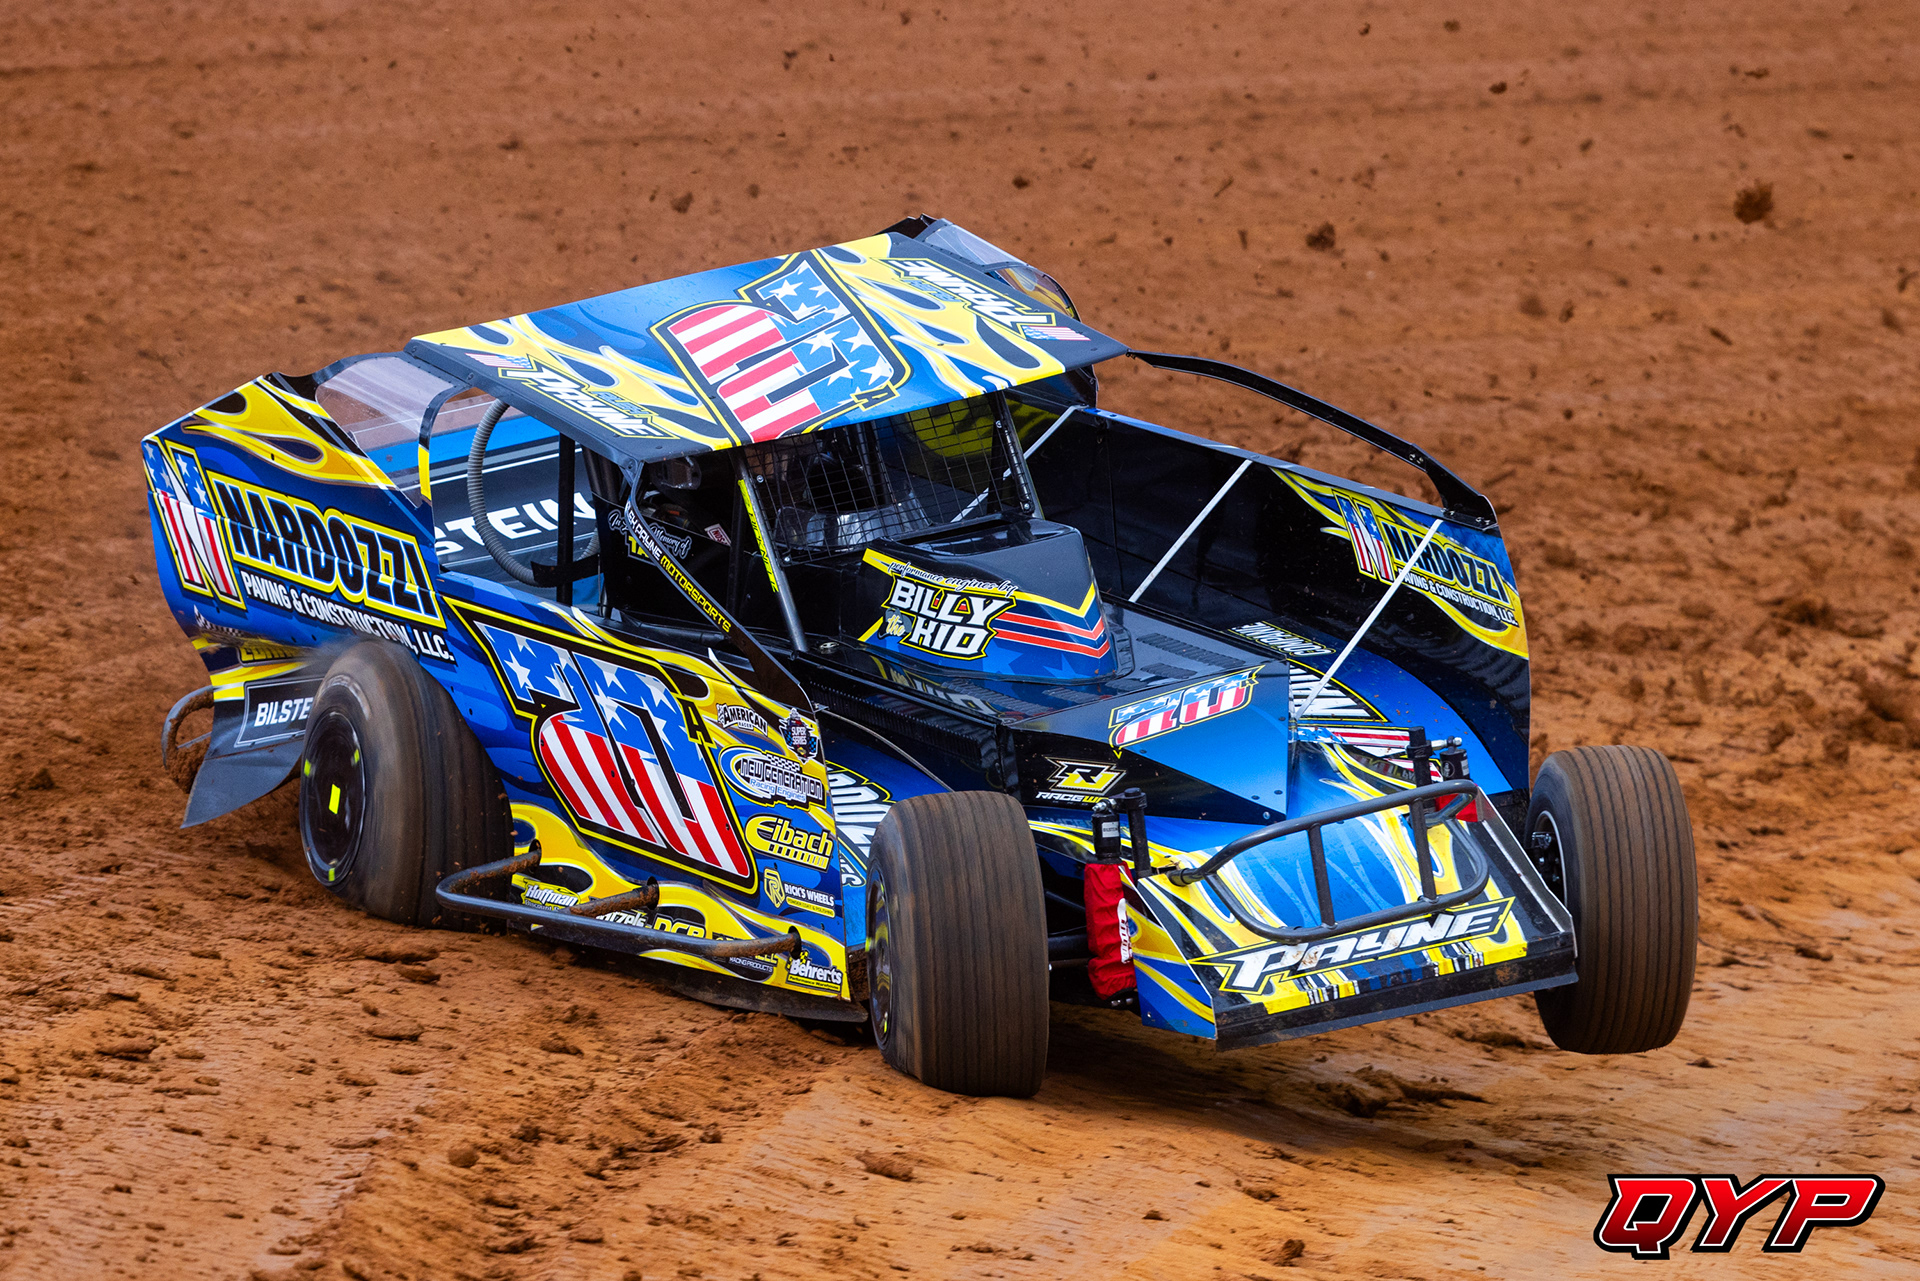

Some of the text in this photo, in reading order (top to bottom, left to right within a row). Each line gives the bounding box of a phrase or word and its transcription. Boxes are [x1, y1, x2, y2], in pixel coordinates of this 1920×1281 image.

[505, 370, 664, 437] PAYNE
[434, 492, 597, 556] STEIN
[214, 480, 440, 619] NARDOZZI
[1380, 520, 1511, 604] NARDOZZI
[660, 555, 732, 633] MOTORSPORTS
[888, 562, 1019, 598] performance engines by
[1398, 567, 1429, 592] AVING
[240, 570, 292, 610] PAVING
[292, 588, 303, 614] &
[412, 628, 455, 661] LLC.
[889, 578, 1012, 627] BILLY
[909, 616, 989, 654] KID
[254, 697, 313, 727] BILSTE
[722, 705, 767, 734] AMERICAN
[791, 726, 806, 736] SUPER
[740, 759, 823, 801] NEW GENERATION
[750, 778, 807, 803] Racing Engines
[745, 816, 833, 859] Eibach
[525, 884, 579, 907] Hoffman
[784, 883, 835, 907] RICK'S WHEELS
[1225, 906, 1500, 989] PAYNE
